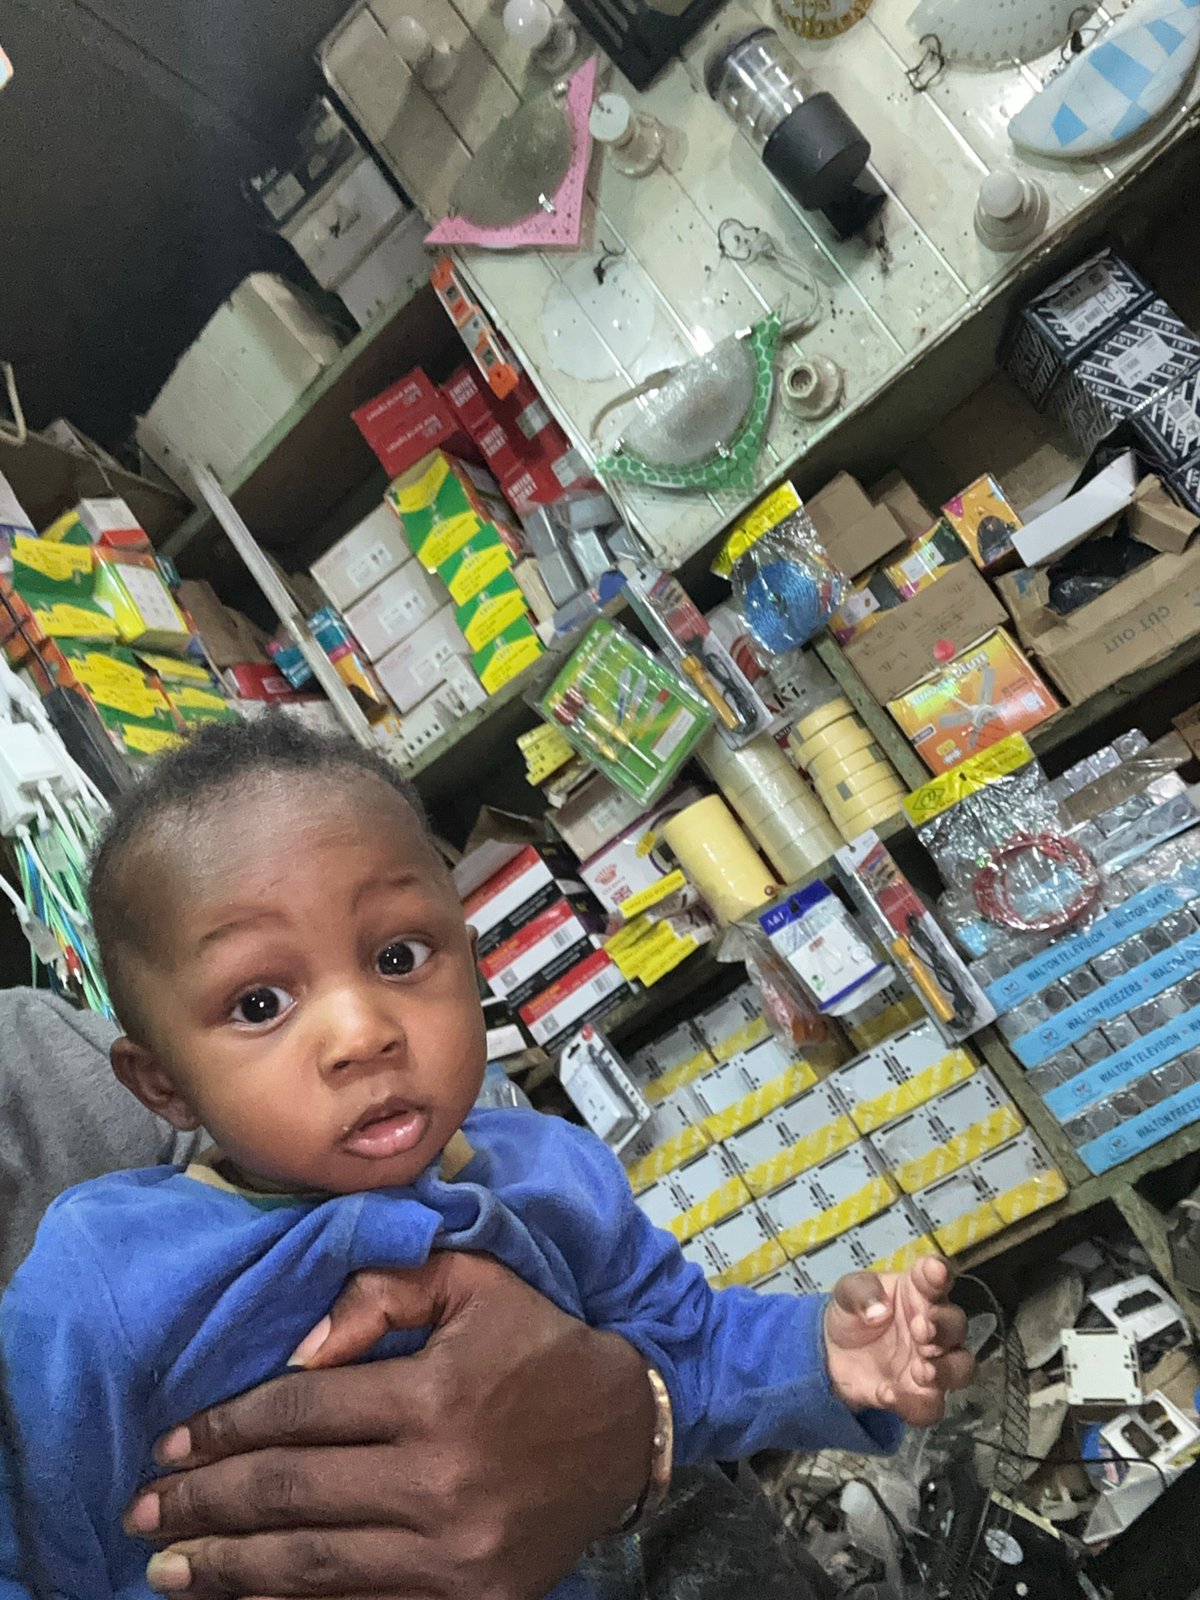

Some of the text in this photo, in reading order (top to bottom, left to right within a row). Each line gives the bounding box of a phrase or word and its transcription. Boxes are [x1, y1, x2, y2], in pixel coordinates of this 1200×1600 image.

[1157, 320, 1179, 334] A&I
[1171, 338, 1193, 352] A&I
[1091, 382, 1112, 394] A&I
[1100, 603, 1173, 654] CUT OUT
[766, 911, 784, 927] A&I
[1026, 959, 1057, 982] WALTON
[1058, 931, 1106, 963] TELEVISION
[1112, 903, 1148, 928] WALTON
[1145, 892, 1166, 909] GAS
[1066, 1004, 1099, 1030] WALTON
[1099, 981, 1143, 1012] FREEZERS
[1149, 954, 1187, 980] WALTON
[1098, 1060, 1132, 1083] WALTON
[1132, 1033, 1181, 1066] TELEVISION
[1135, 1112, 1173, 1138] WALTON
